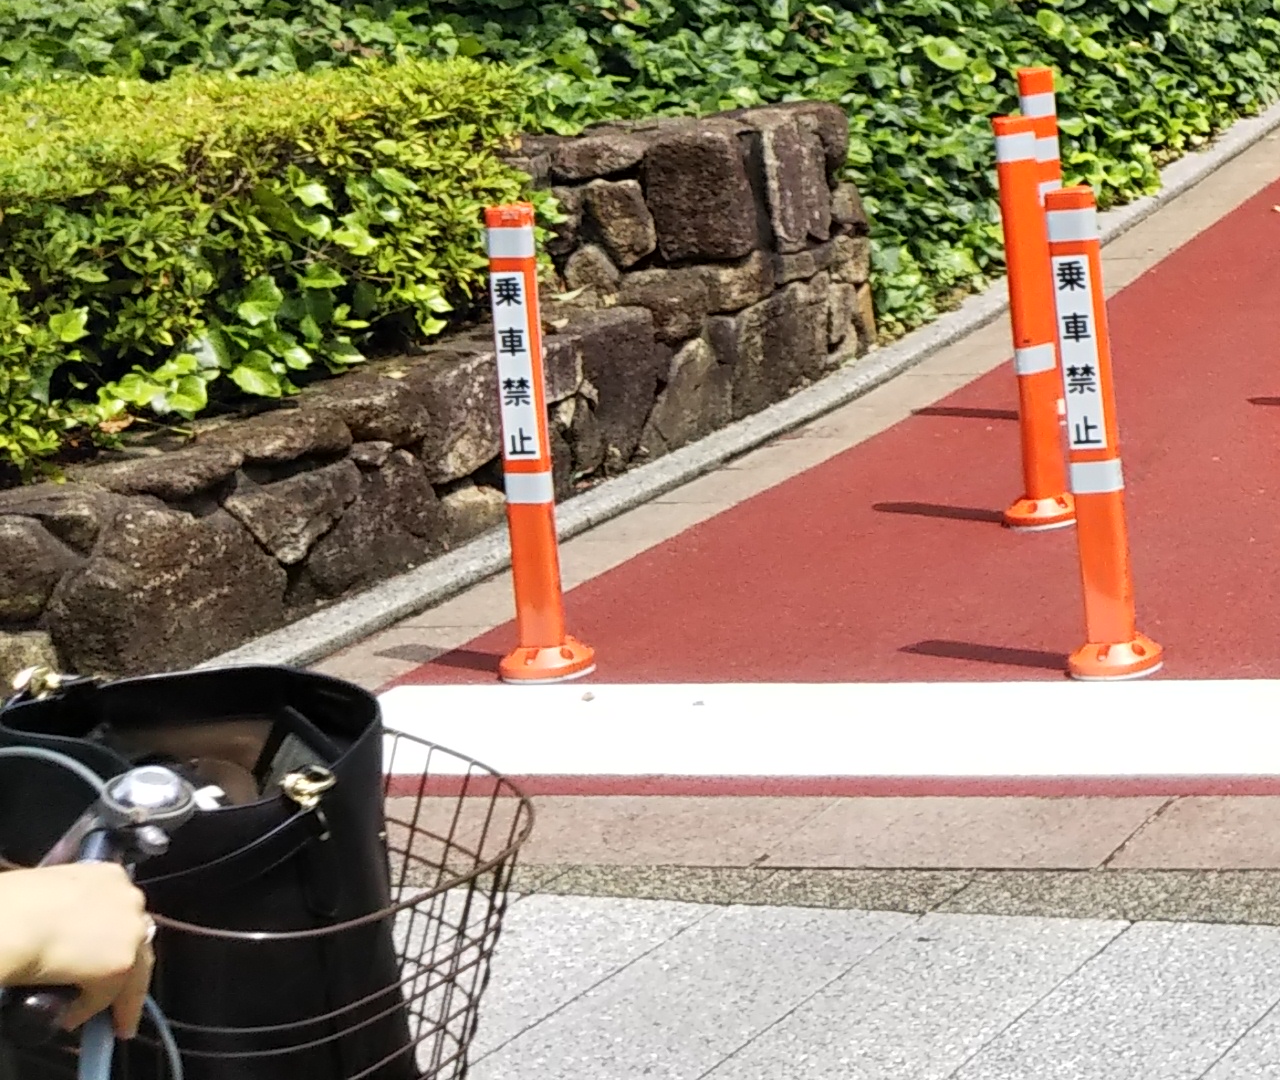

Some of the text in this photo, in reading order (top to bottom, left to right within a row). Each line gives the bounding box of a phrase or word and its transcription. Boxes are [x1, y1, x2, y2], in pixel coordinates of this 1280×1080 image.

[494, 277, 537, 456] 乗車禁止
[1056, 261, 1102, 445] 乗車禁止
